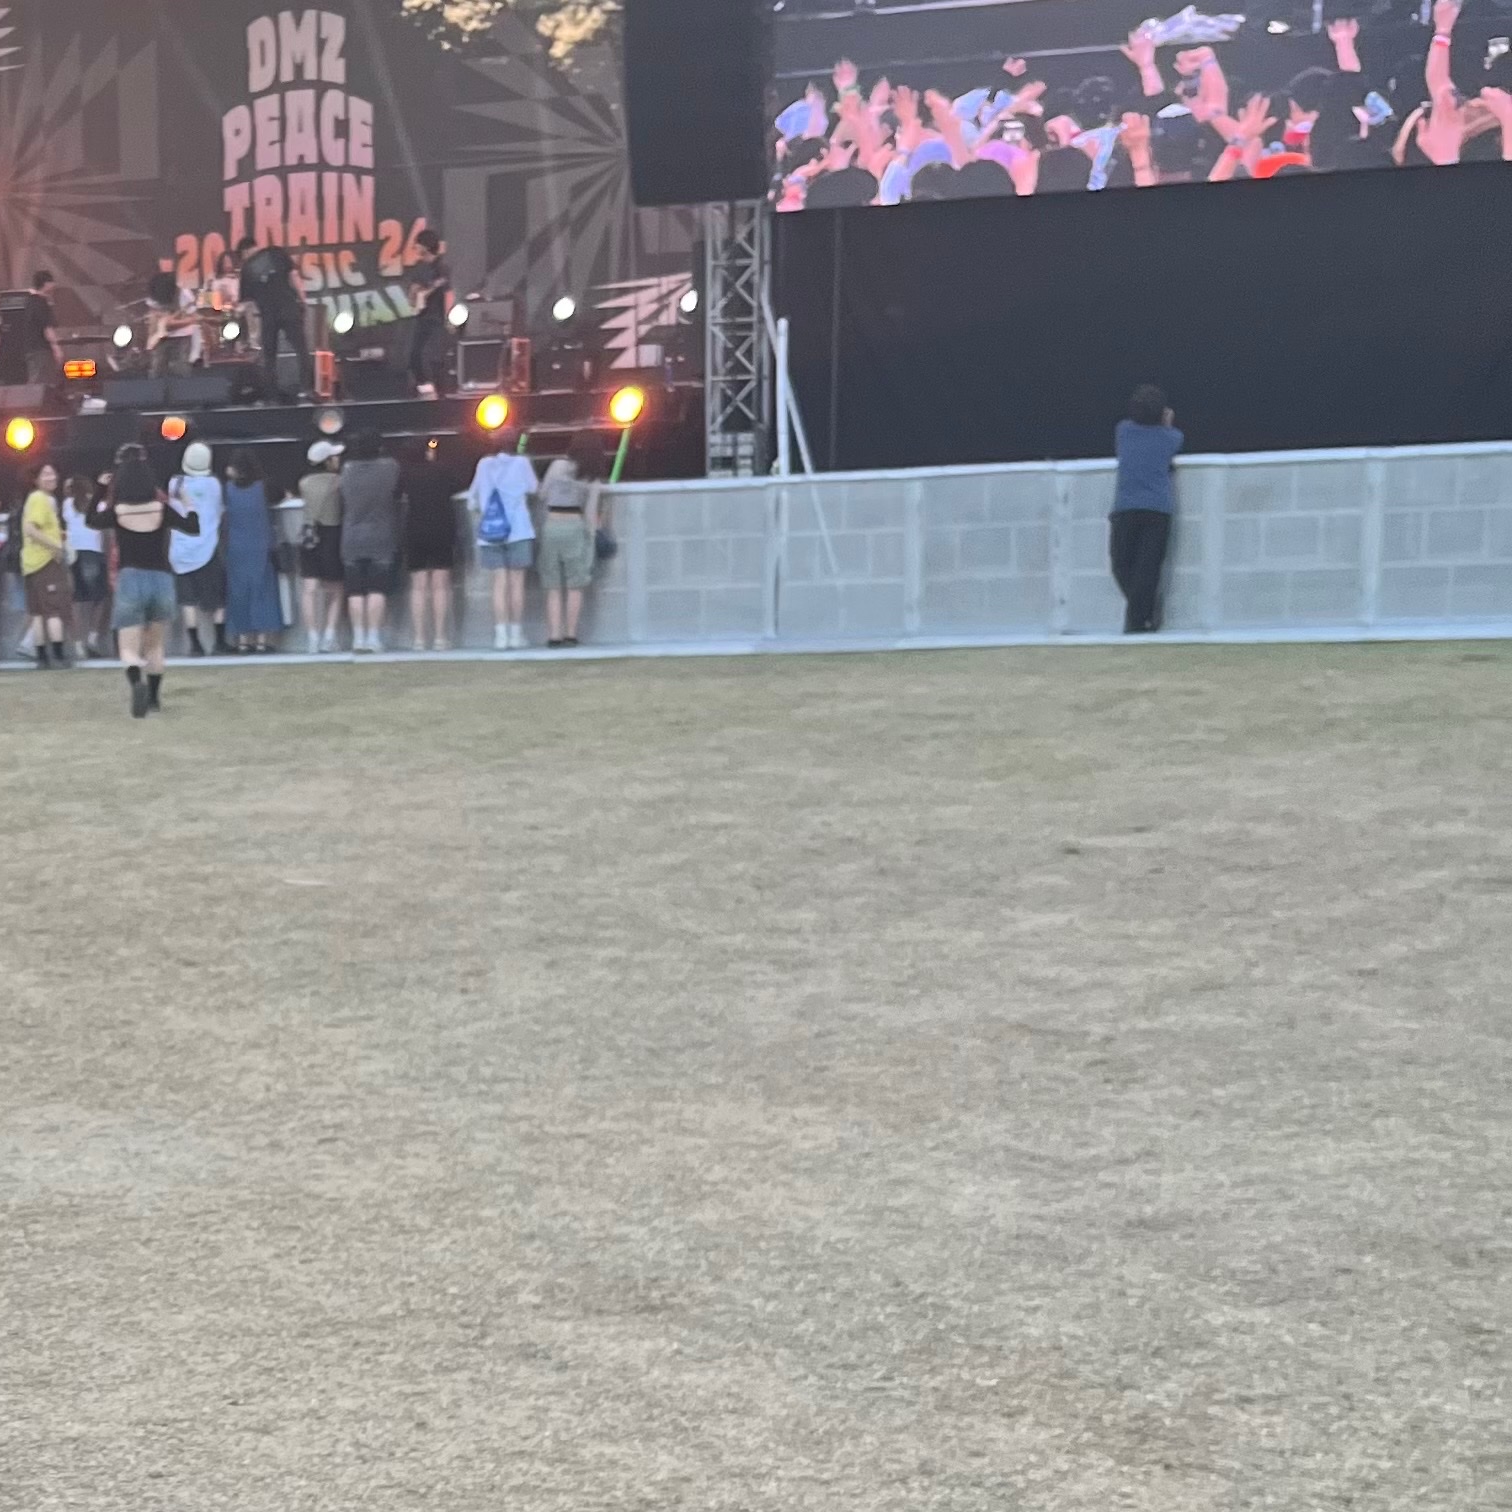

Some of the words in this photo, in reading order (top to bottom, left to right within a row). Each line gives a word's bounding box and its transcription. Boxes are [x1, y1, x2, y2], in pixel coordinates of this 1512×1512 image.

[247, 9, 346, 93] DMZ
[222, 89, 375, 181] PEACE
[224, 171, 375, 251] TRAIN
[289, 250, 366, 292] SIC
